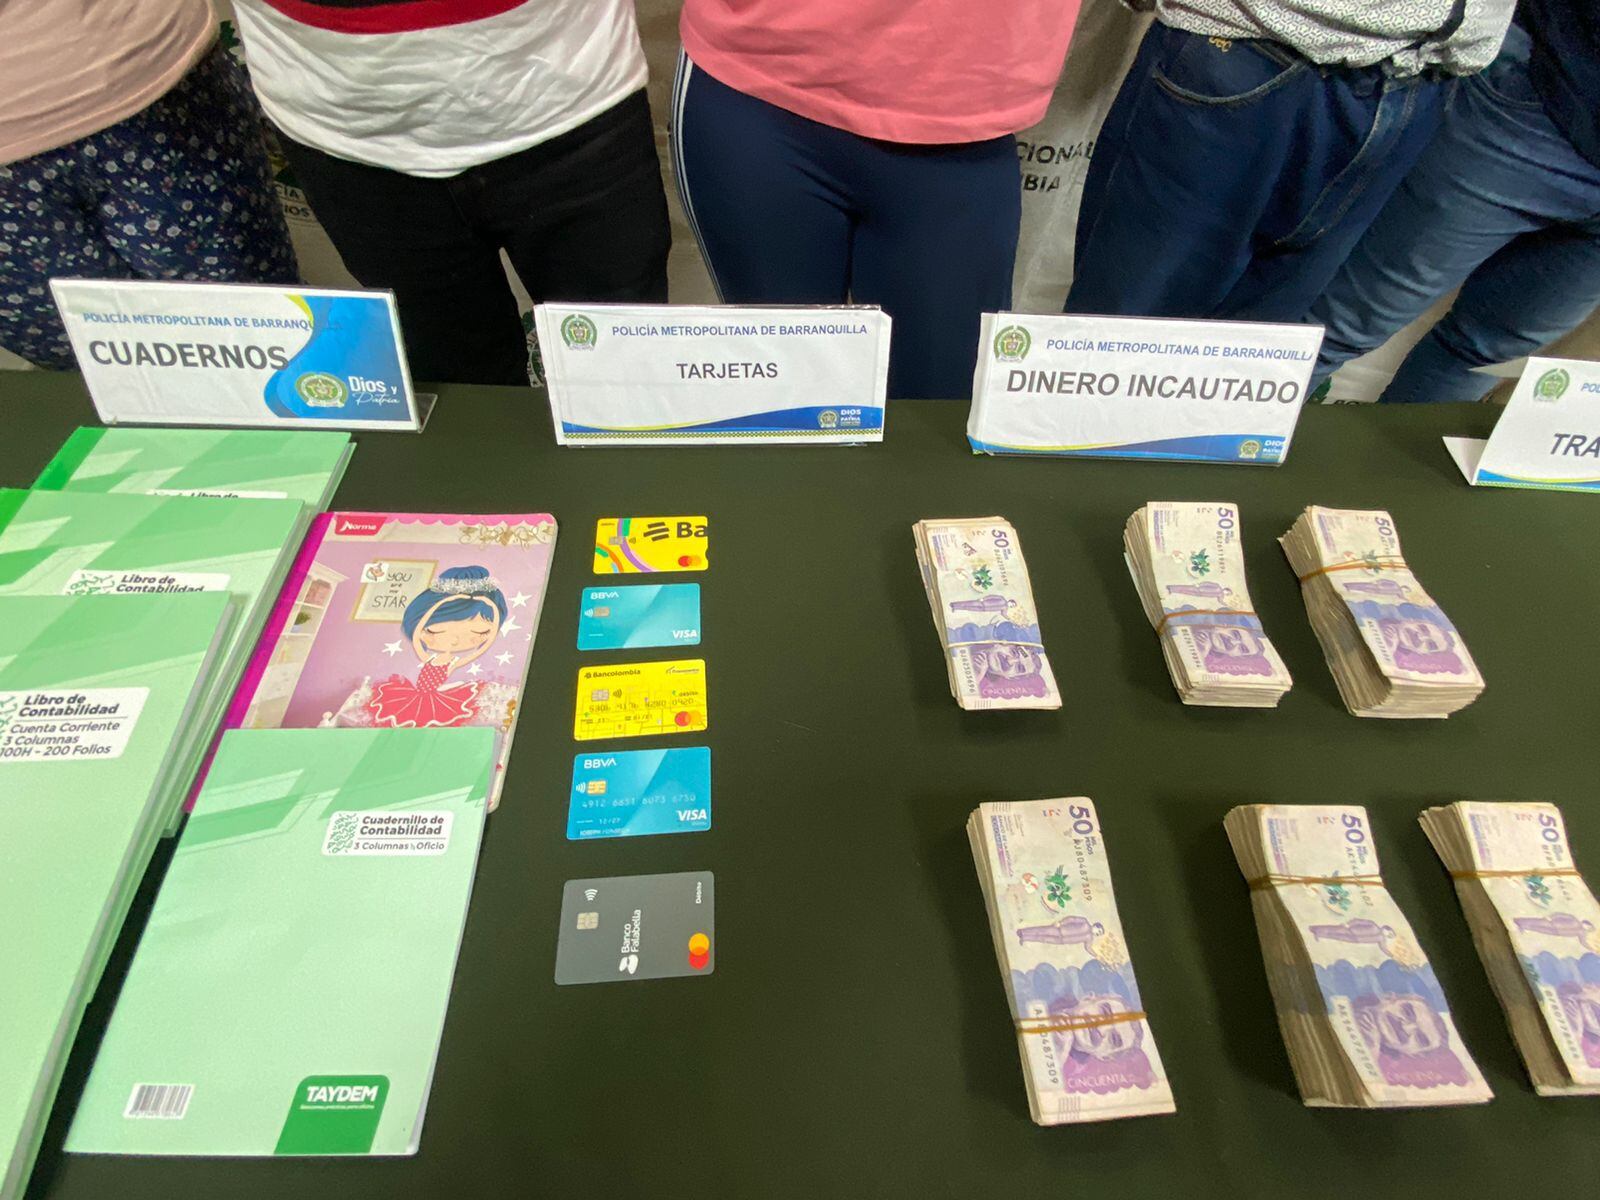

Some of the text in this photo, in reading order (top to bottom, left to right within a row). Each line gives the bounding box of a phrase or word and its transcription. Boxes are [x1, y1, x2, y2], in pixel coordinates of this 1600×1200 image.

[133, 315, 230, 328] METROPOLITANA
[234, 317, 249, 328] DE
[612, 324, 867, 337] POLICÍA METROPOLITANA DE BARRANQUILLA
[1046, 338, 1094, 351] POLICÍA
[1097, 341, 1199, 356] METROPOLITANA
[1202, 346, 1219, 357] DE
[89, 341, 289, 370] CUADERNOS
[676, 363, 778, 379] TARJETAS
[348, 376, 397, 395] Dios y
[1007, 370, 1299, 403] DINERO INCAUTADO
[1218, 507, 1234, 529] 50
[1375, 516, 1393, 537] 50
[992, 529, 1009, 548] 50
[121, 574, 176, 584] Libro de
[387, 572, 412, 582] YOU
[116, 583, 205, 592] Contabilidad
[372, 596, 407, 608] STAR
[590, 592, 619, 600] BBVA
[672, 630, 698, 639] VISA
[593, 669, 641, 678] Bancolombia
[24, 694, 86, 706] Libro de
[19, 704, 120, 717] Contabilidad
[11, 721, 120, 734] Cuenta Corriente
[3, 735, 79, 746] 3 Columnas
[43, 746, 70, 756] 200
[73, 744, 111, 755] Folios
[584, 758, 617, 769] BBVA
[362, 815, 444, 825] Cuadernillo de
[676, 809, 707, 821] VISA
[1069, 804, 1094, 836] 50
[360, 825, 442, 835] Contabilidad
[1341, 813, 1365, 844] 50
[1539, 813, 1559, 842] 50
[354, 842, 360, 850] 3
[362, 841, 409, 850] Columnas
[416, 841, 445, 850] Oficio
[631, 909, 642, 953] Falabella
[621, 923, 631, 954] Banco
[1033, 1008, 1059, 1084] A0487309
[307, 1085, 378, 1102] TAYDEM
